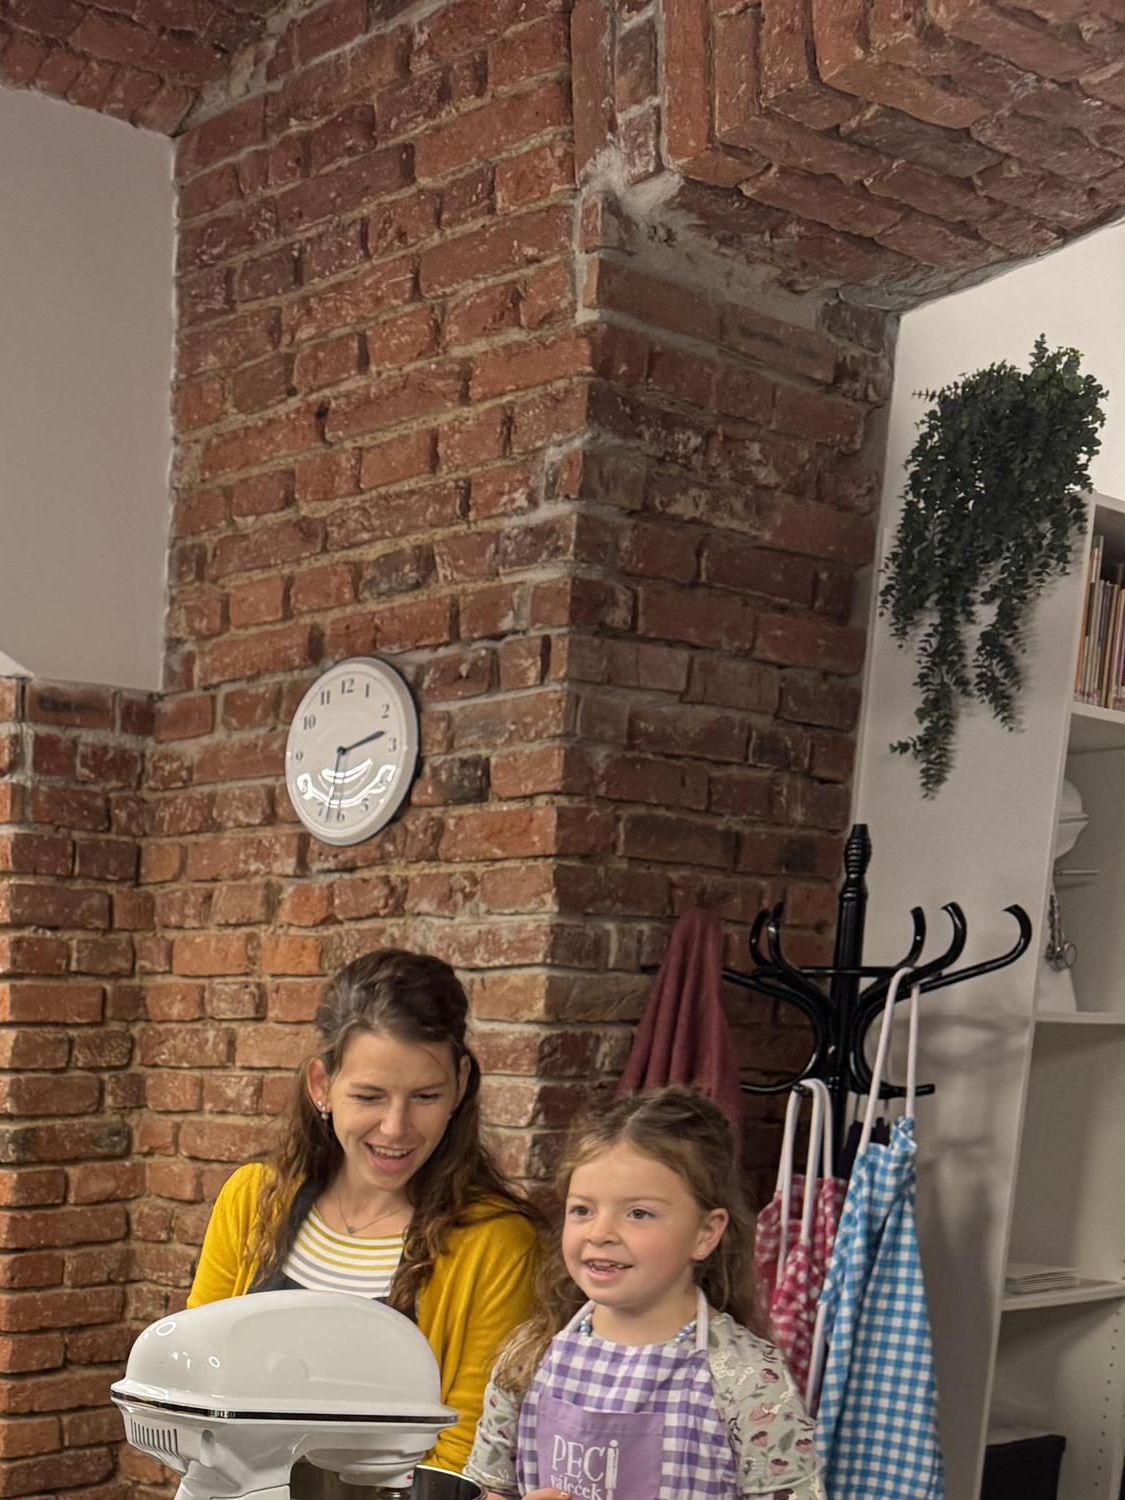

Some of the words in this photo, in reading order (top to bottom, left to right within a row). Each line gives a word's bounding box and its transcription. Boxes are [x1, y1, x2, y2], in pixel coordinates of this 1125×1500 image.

[341, 678, 355, 695] 12
[365, 683, 370, 698] 1
[320, 690, 331, 706] 11
[381, 704, 390, 719] 2
[303, 715, 316, 730] 10
[389, 737, 397, 752] 3
[295, 751, 304, 763] 9
[316, 802, 325, 817] 7
